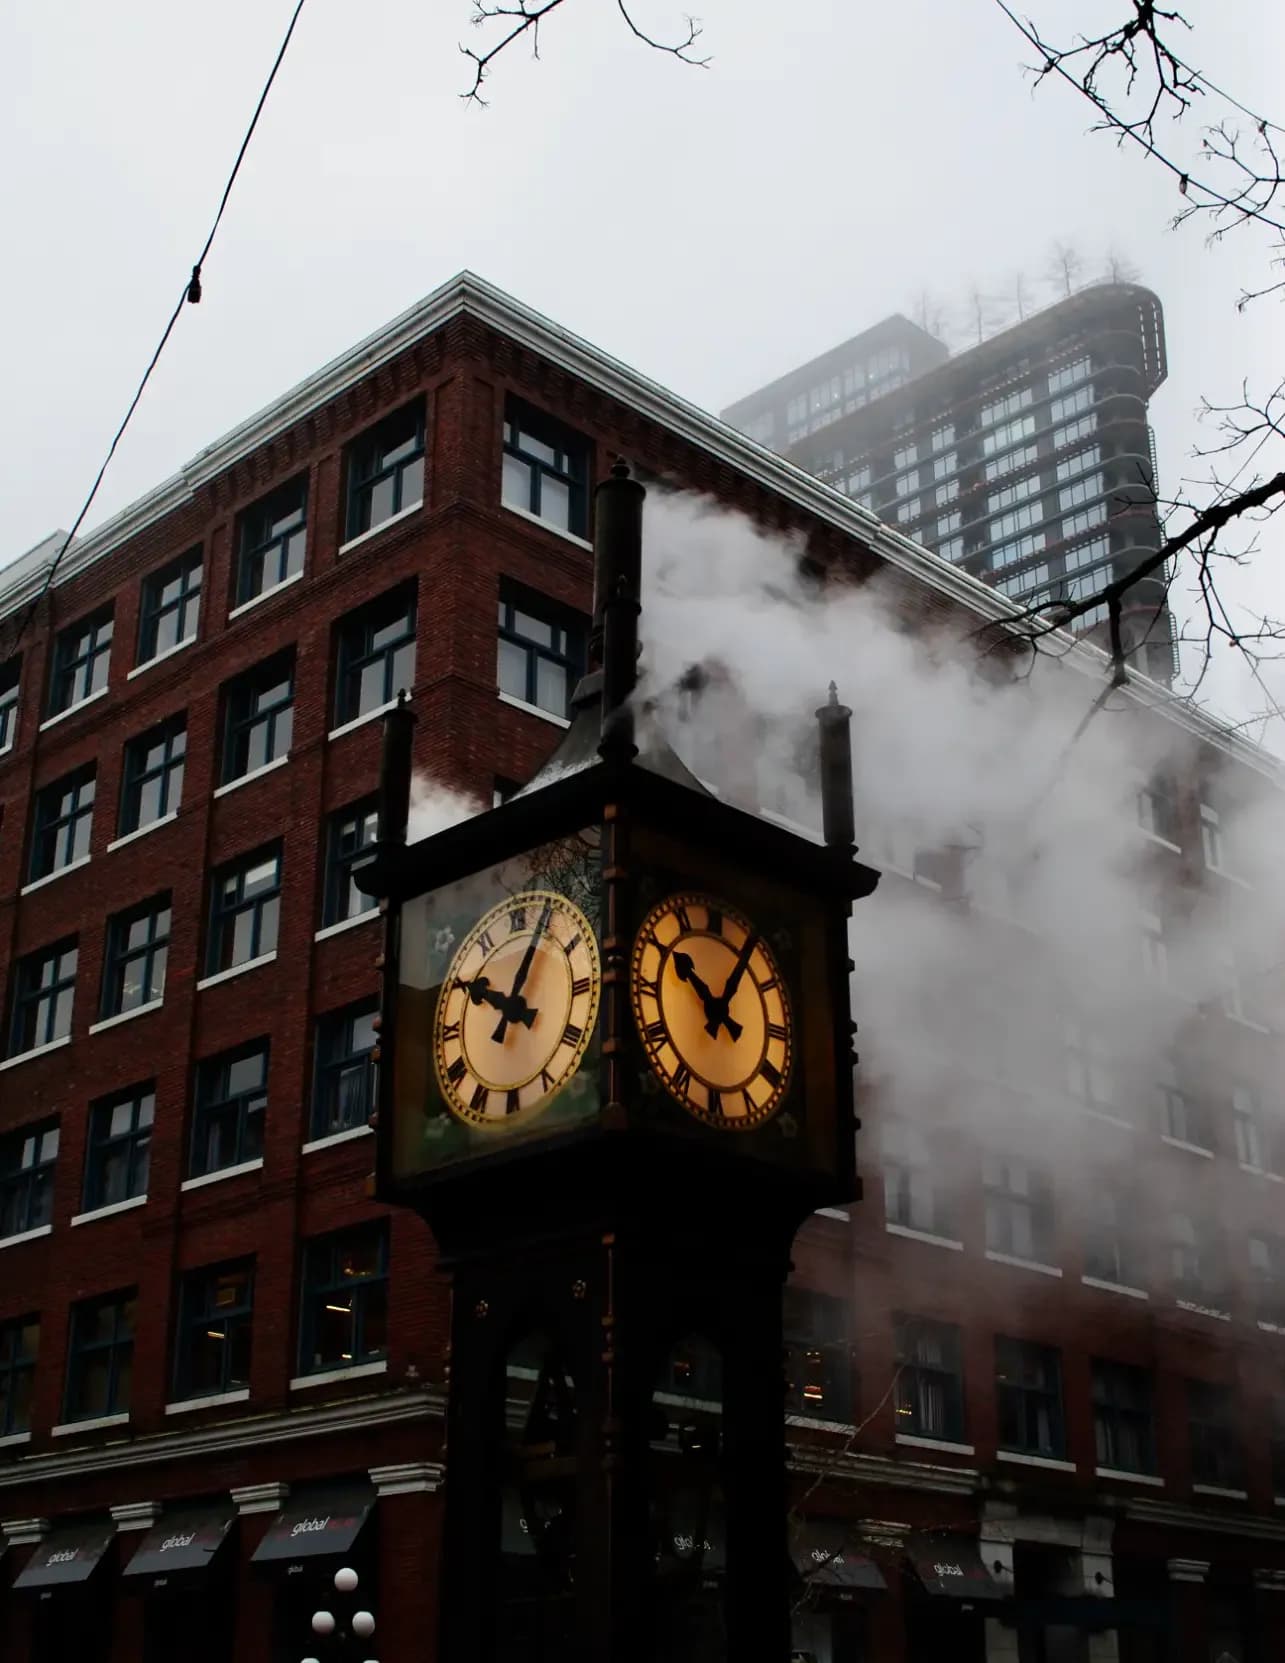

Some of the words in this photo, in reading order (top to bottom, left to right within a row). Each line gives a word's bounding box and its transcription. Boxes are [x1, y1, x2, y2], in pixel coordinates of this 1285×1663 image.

[572, 977, 590, 996] III
[767, 1023, 787, 1040] III
[541, 1068, 555, 1092] V
[291, 1515, 331, 1537] global
